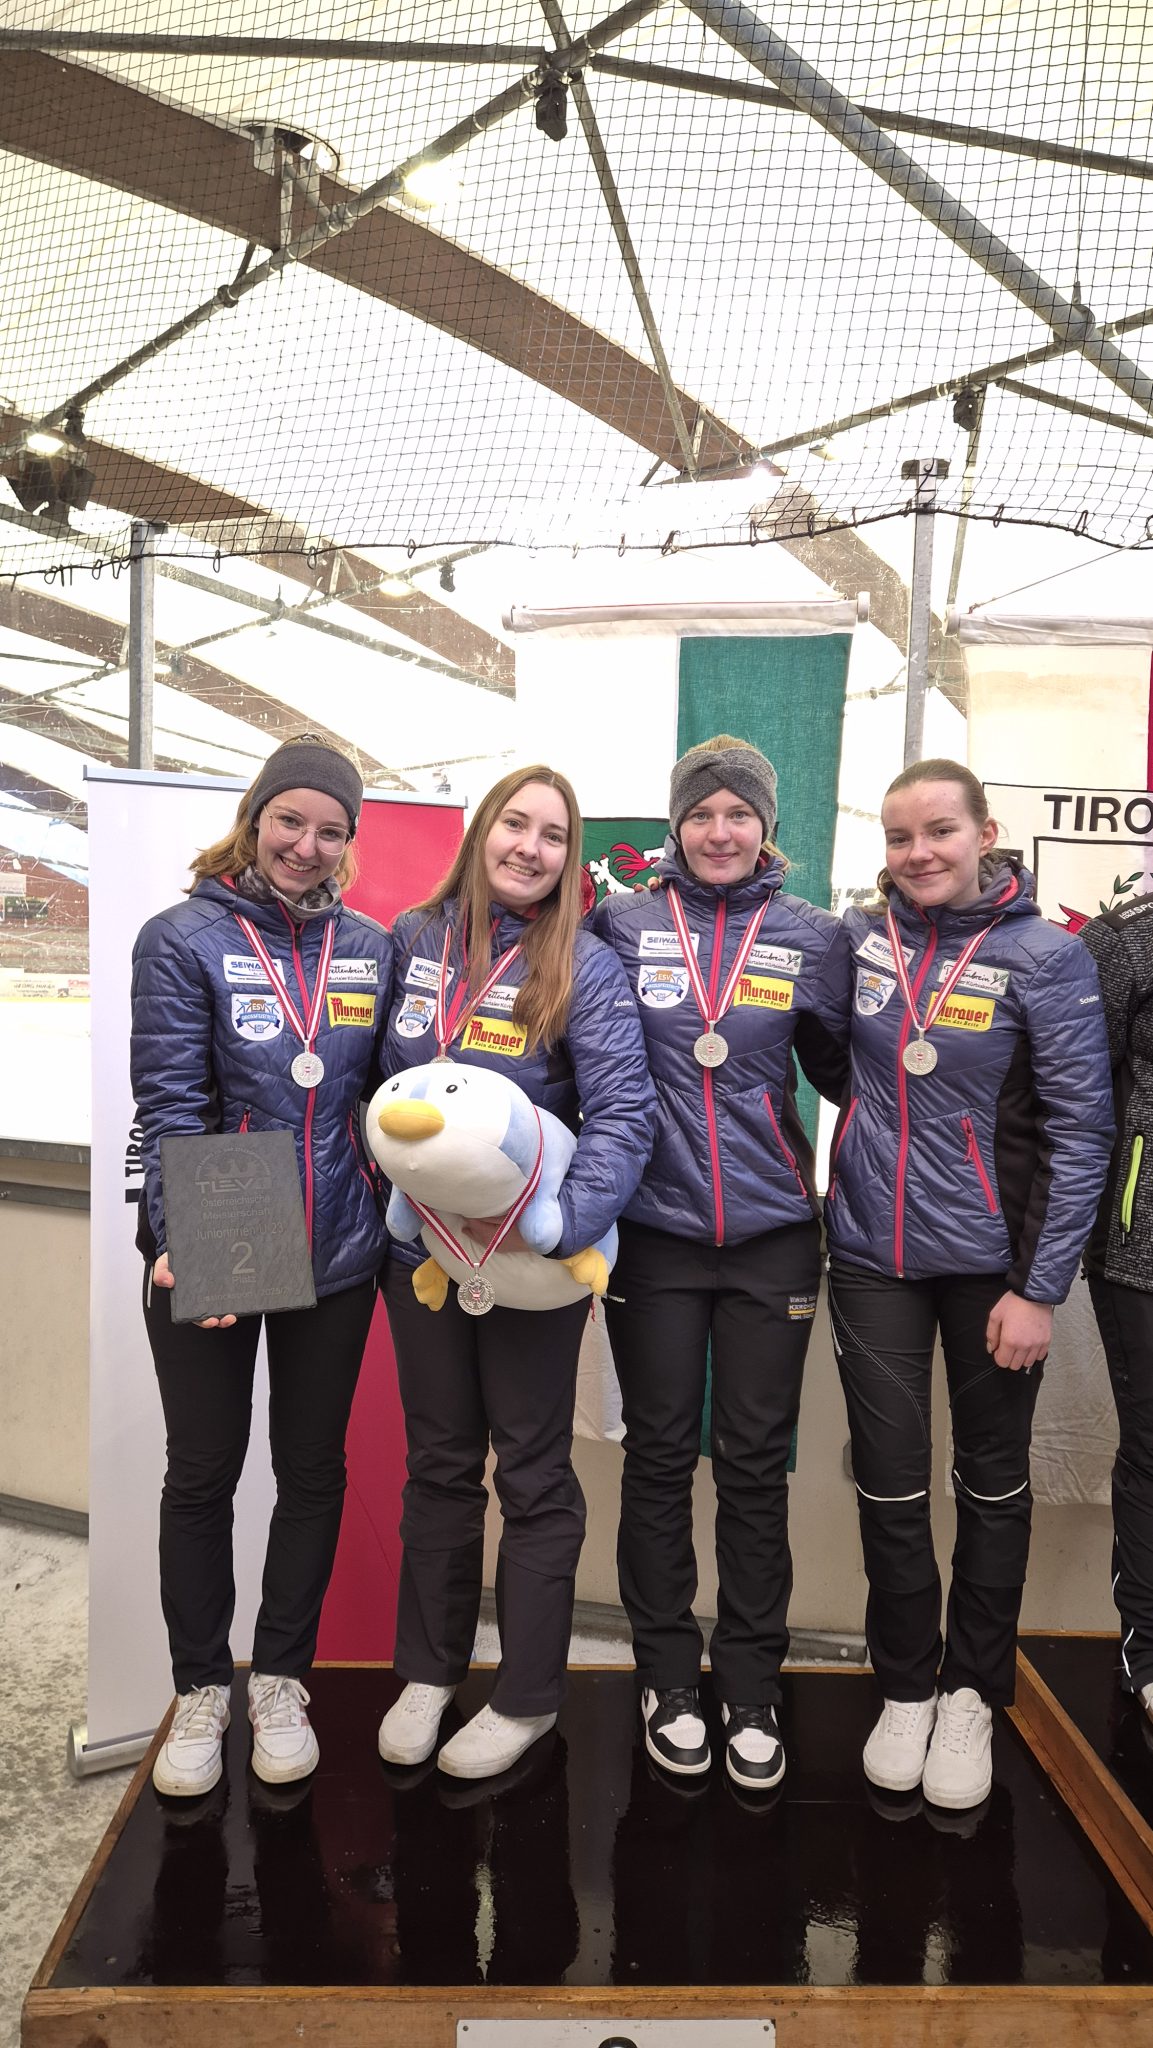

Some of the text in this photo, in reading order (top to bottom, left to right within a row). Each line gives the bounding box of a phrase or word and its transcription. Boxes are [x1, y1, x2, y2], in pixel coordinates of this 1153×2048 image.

[647, 936, 695, 944] SEIWAL
[414, 964, 453, 976] SEIWAL
[739, 978, 790, 1004] Murauer
[330, 997, 373, 1022] Murauer
[938, 1003, 990, 1023] urauer
[468, 1020, 523, 1048] Murauer
[230, 1241, 256, 1275] 2
